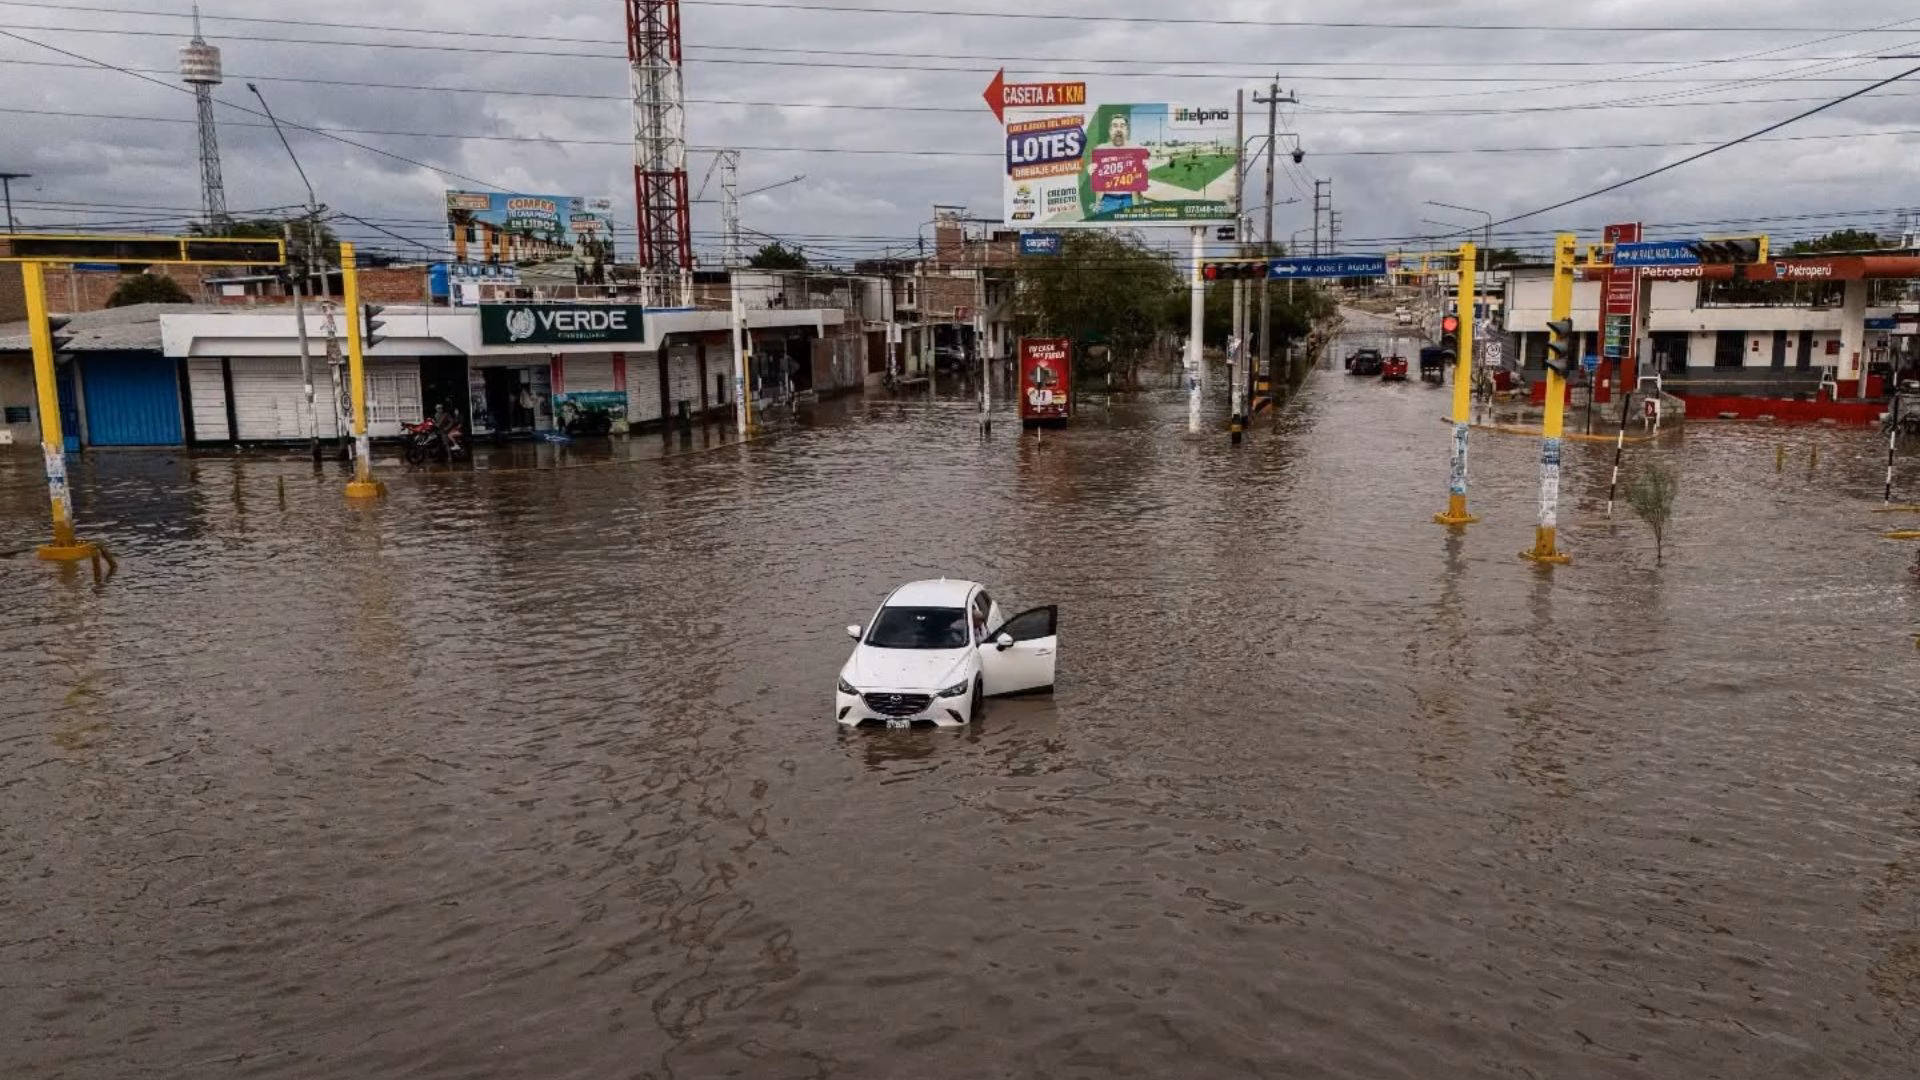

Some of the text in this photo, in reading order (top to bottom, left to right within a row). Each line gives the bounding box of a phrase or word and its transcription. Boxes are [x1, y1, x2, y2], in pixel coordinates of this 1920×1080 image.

[1003, 85, 1084, 104] CASETA A 1 KM
[1011, 132, 1081, 162] LOTES
[508, 198, 556, 214] COMPRA
[1347, 263, 1382, 271] AGUILAR
[1641, 265, 1703, 278] Petroperú
[1788, 263, 1832, 279] Petroperú
[537, 310, 628, 331] VERDE
